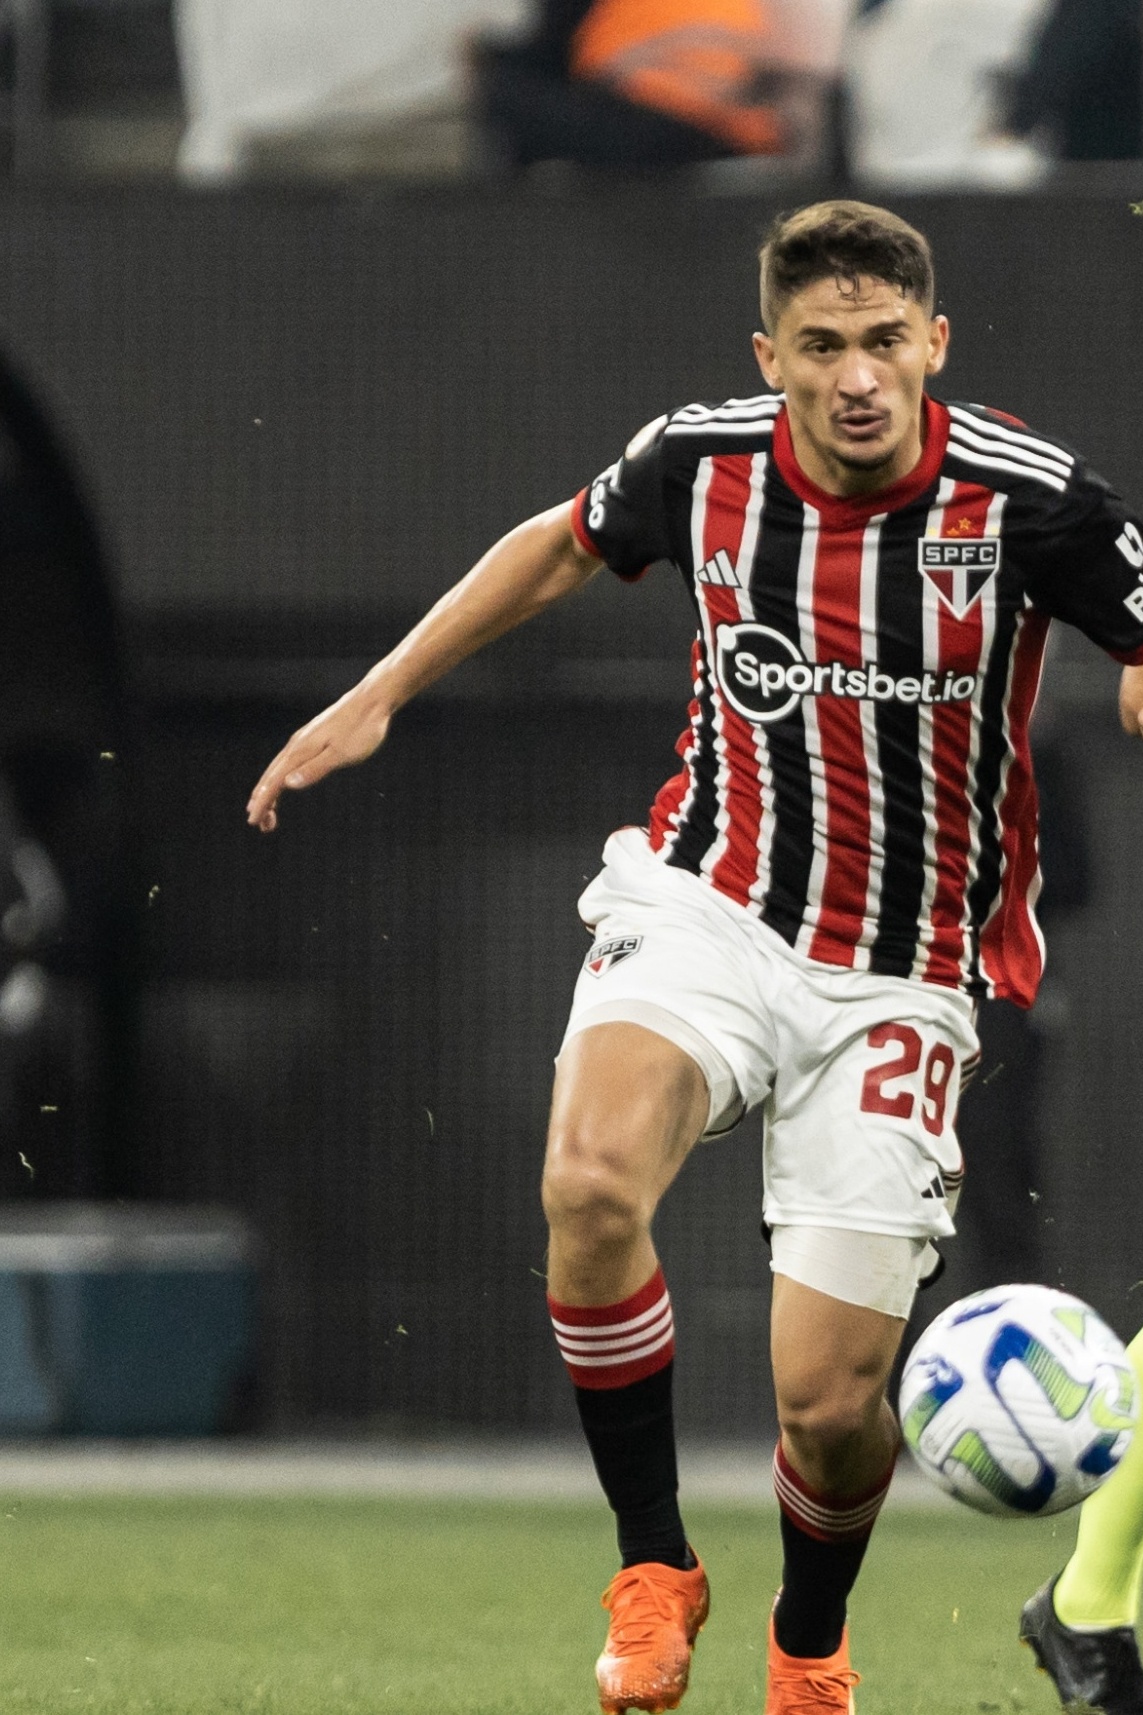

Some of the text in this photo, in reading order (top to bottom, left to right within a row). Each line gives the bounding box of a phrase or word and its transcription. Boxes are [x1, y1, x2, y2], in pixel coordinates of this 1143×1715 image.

[925, 546, 995, 563] SPFC
[734, 651, 976, 702] Sportsbet.io
[859, 1021, 955, 1137] 29
